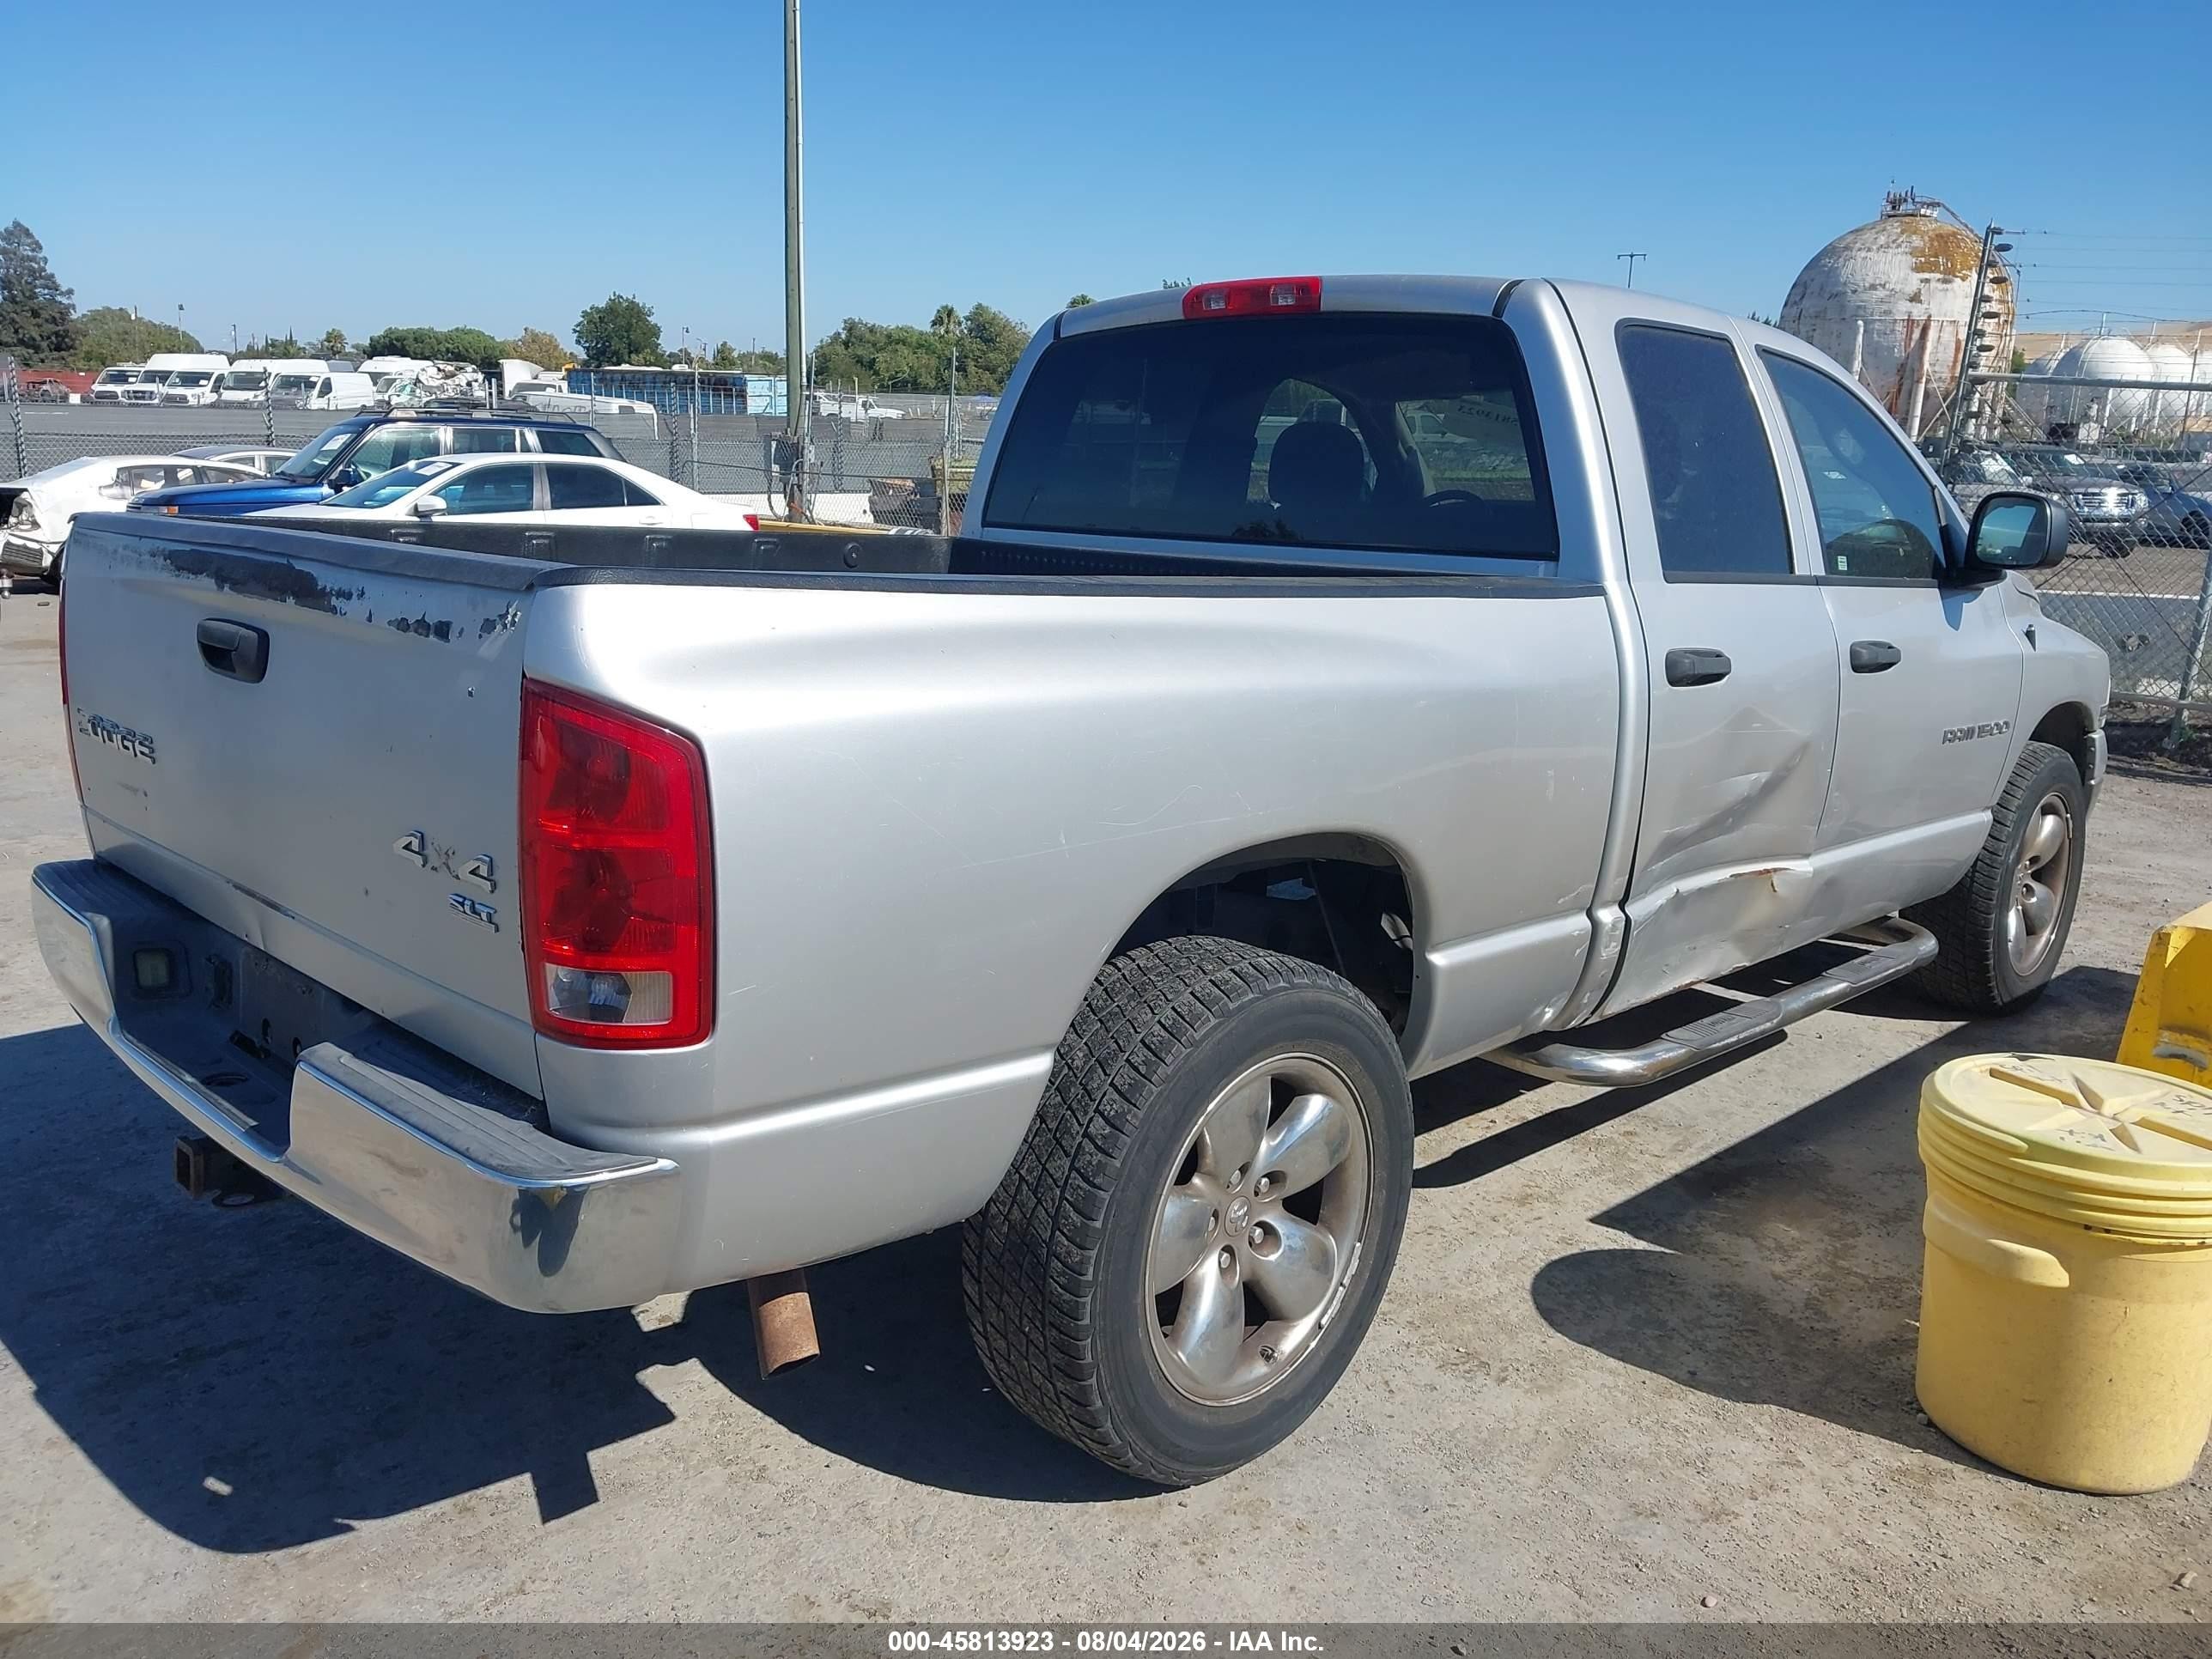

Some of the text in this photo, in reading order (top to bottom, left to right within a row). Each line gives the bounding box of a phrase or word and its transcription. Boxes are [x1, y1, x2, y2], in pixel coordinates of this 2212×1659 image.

[77, 707, 156, 765] ODGE
[1942, 720, 2010, 744] RAM 1500
[447, 893, 500, 933] SLT
